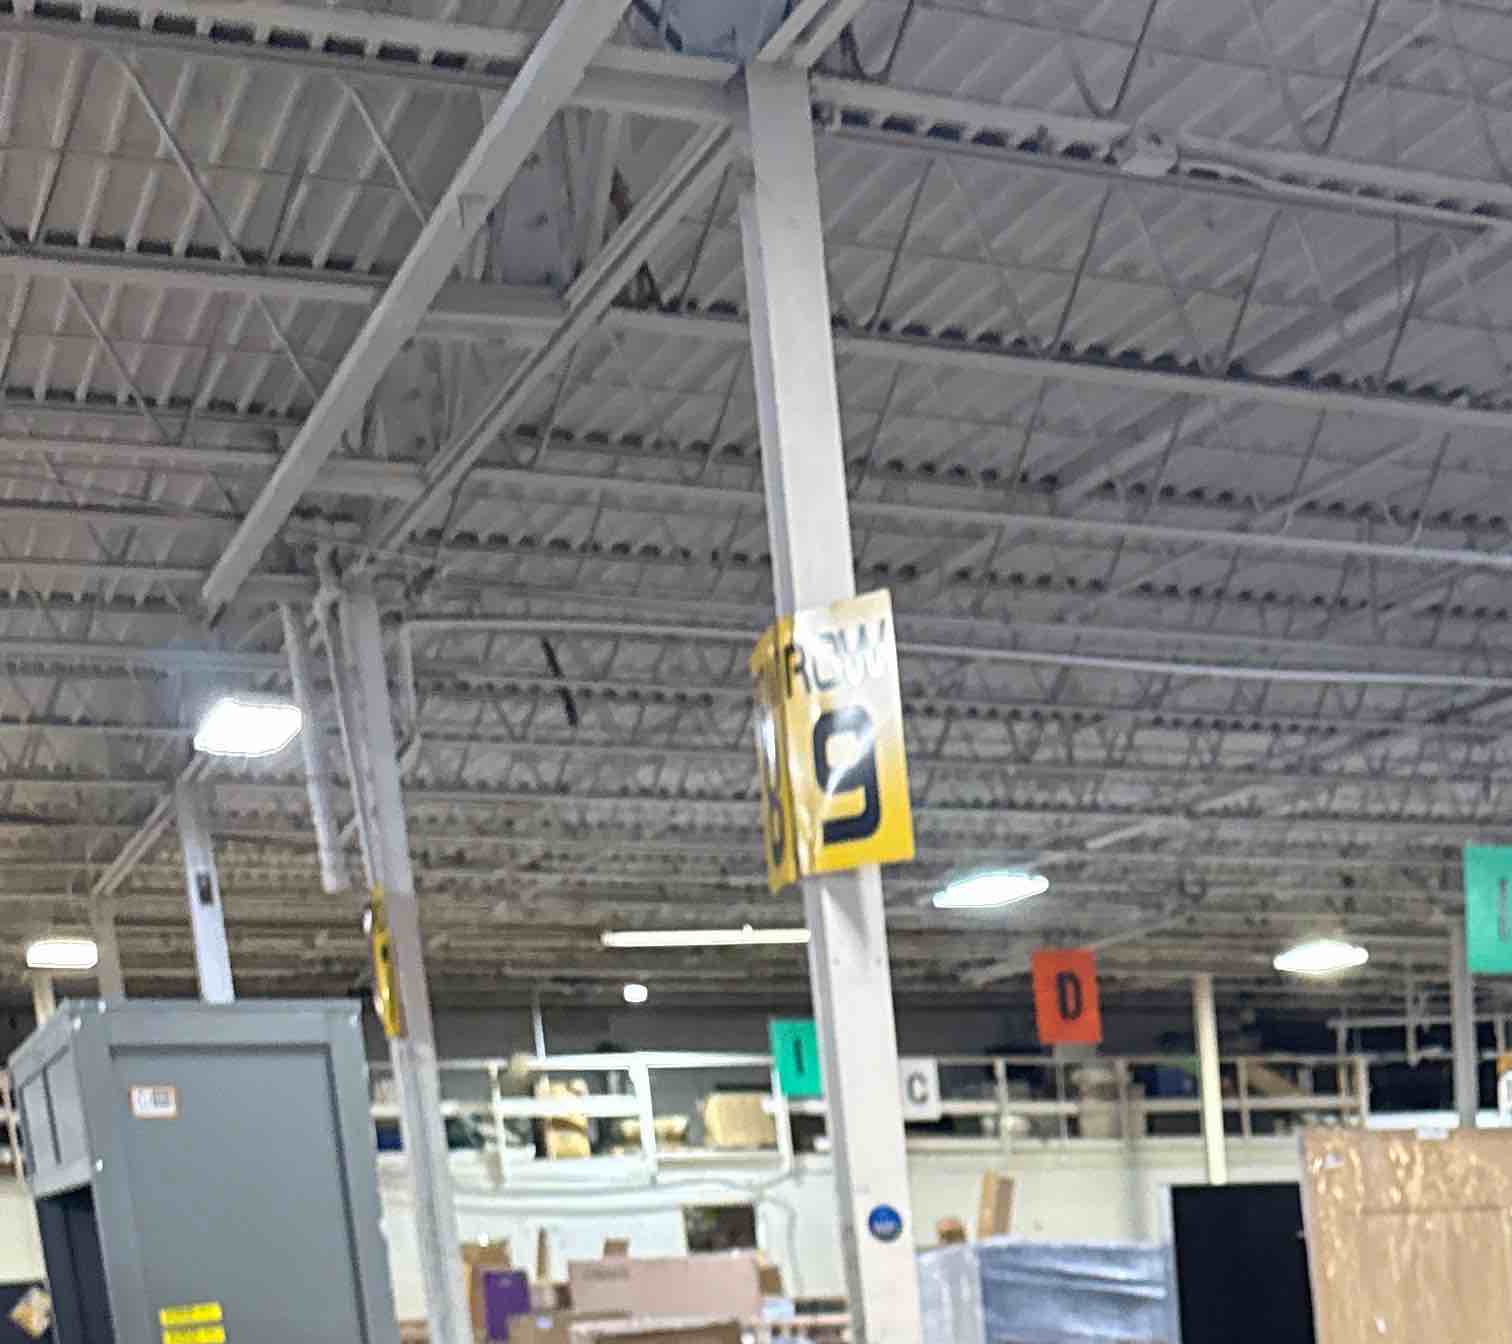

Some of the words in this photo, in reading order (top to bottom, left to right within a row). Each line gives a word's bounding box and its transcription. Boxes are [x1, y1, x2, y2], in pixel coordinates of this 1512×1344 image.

[813, 704, 881, 845] 9
[1056, 970, 1083, 1021] D
[906, 1071, 929, 1105] C
